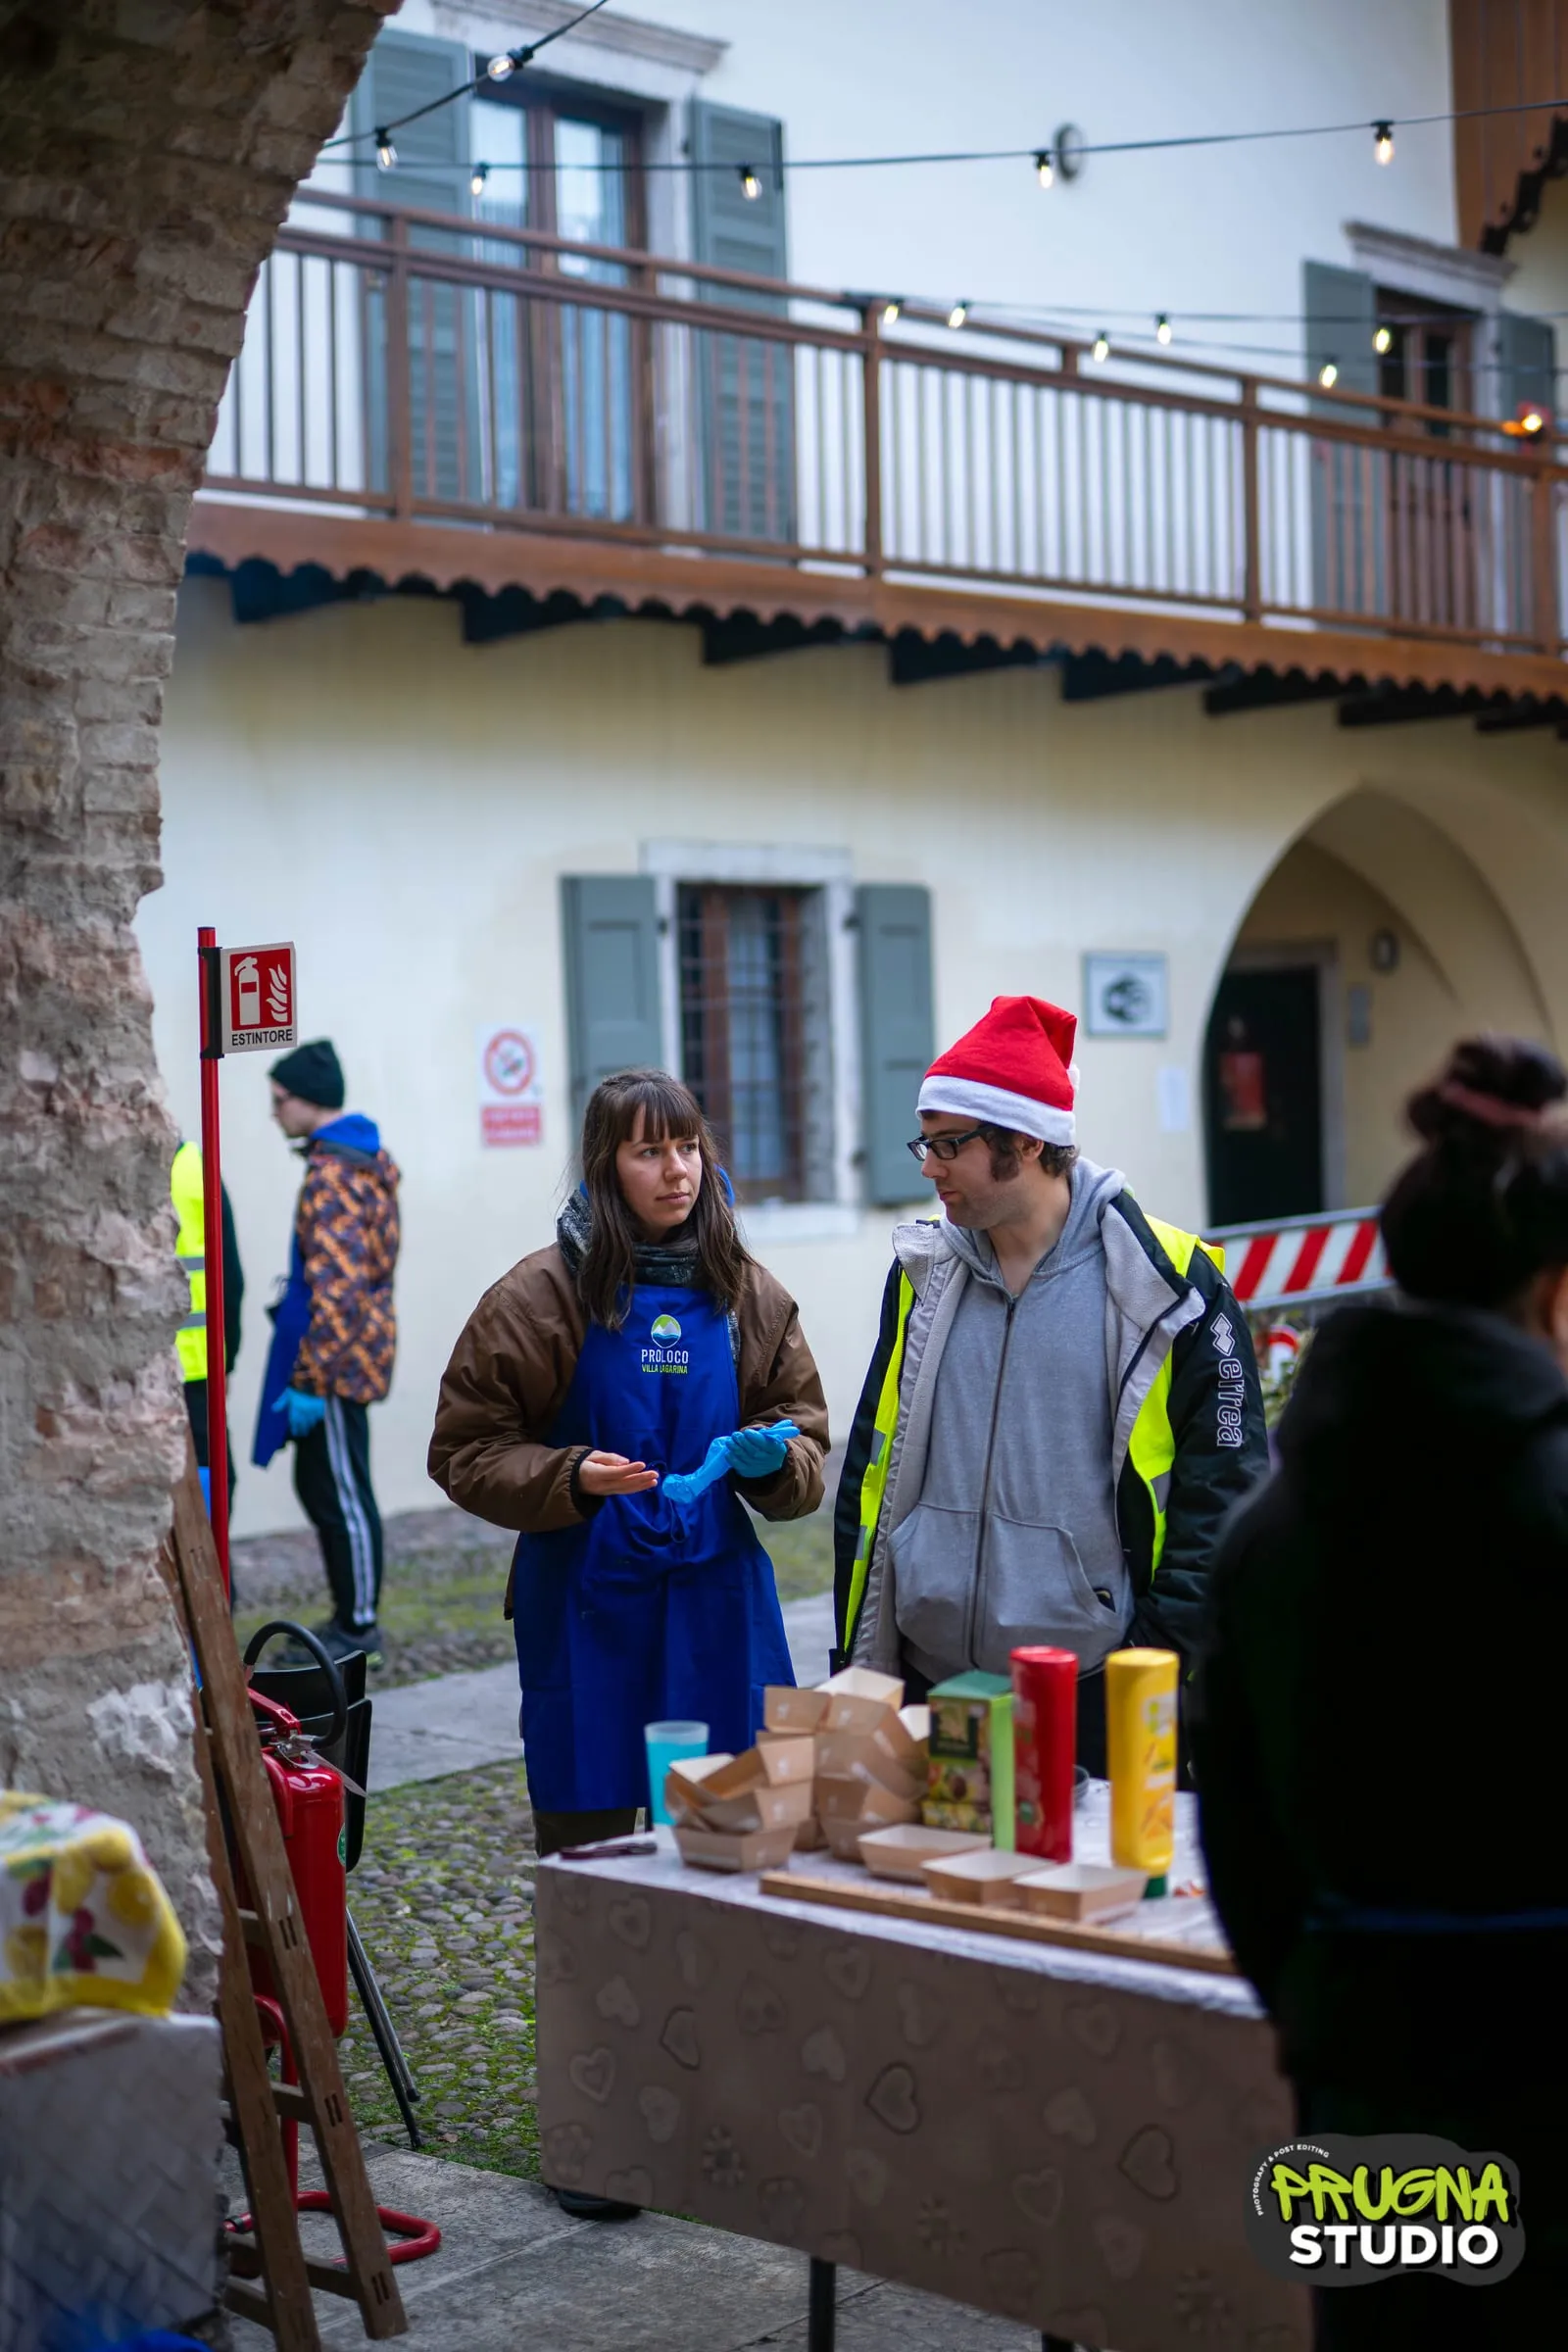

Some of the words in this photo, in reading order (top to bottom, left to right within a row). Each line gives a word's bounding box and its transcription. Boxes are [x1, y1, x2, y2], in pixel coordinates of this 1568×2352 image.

[231, 1029, 293, 1046] ESTINTORE
[641, 1348, 689, 1364] PROLOCO
[642, 1363, 659, 1373] VILLA
